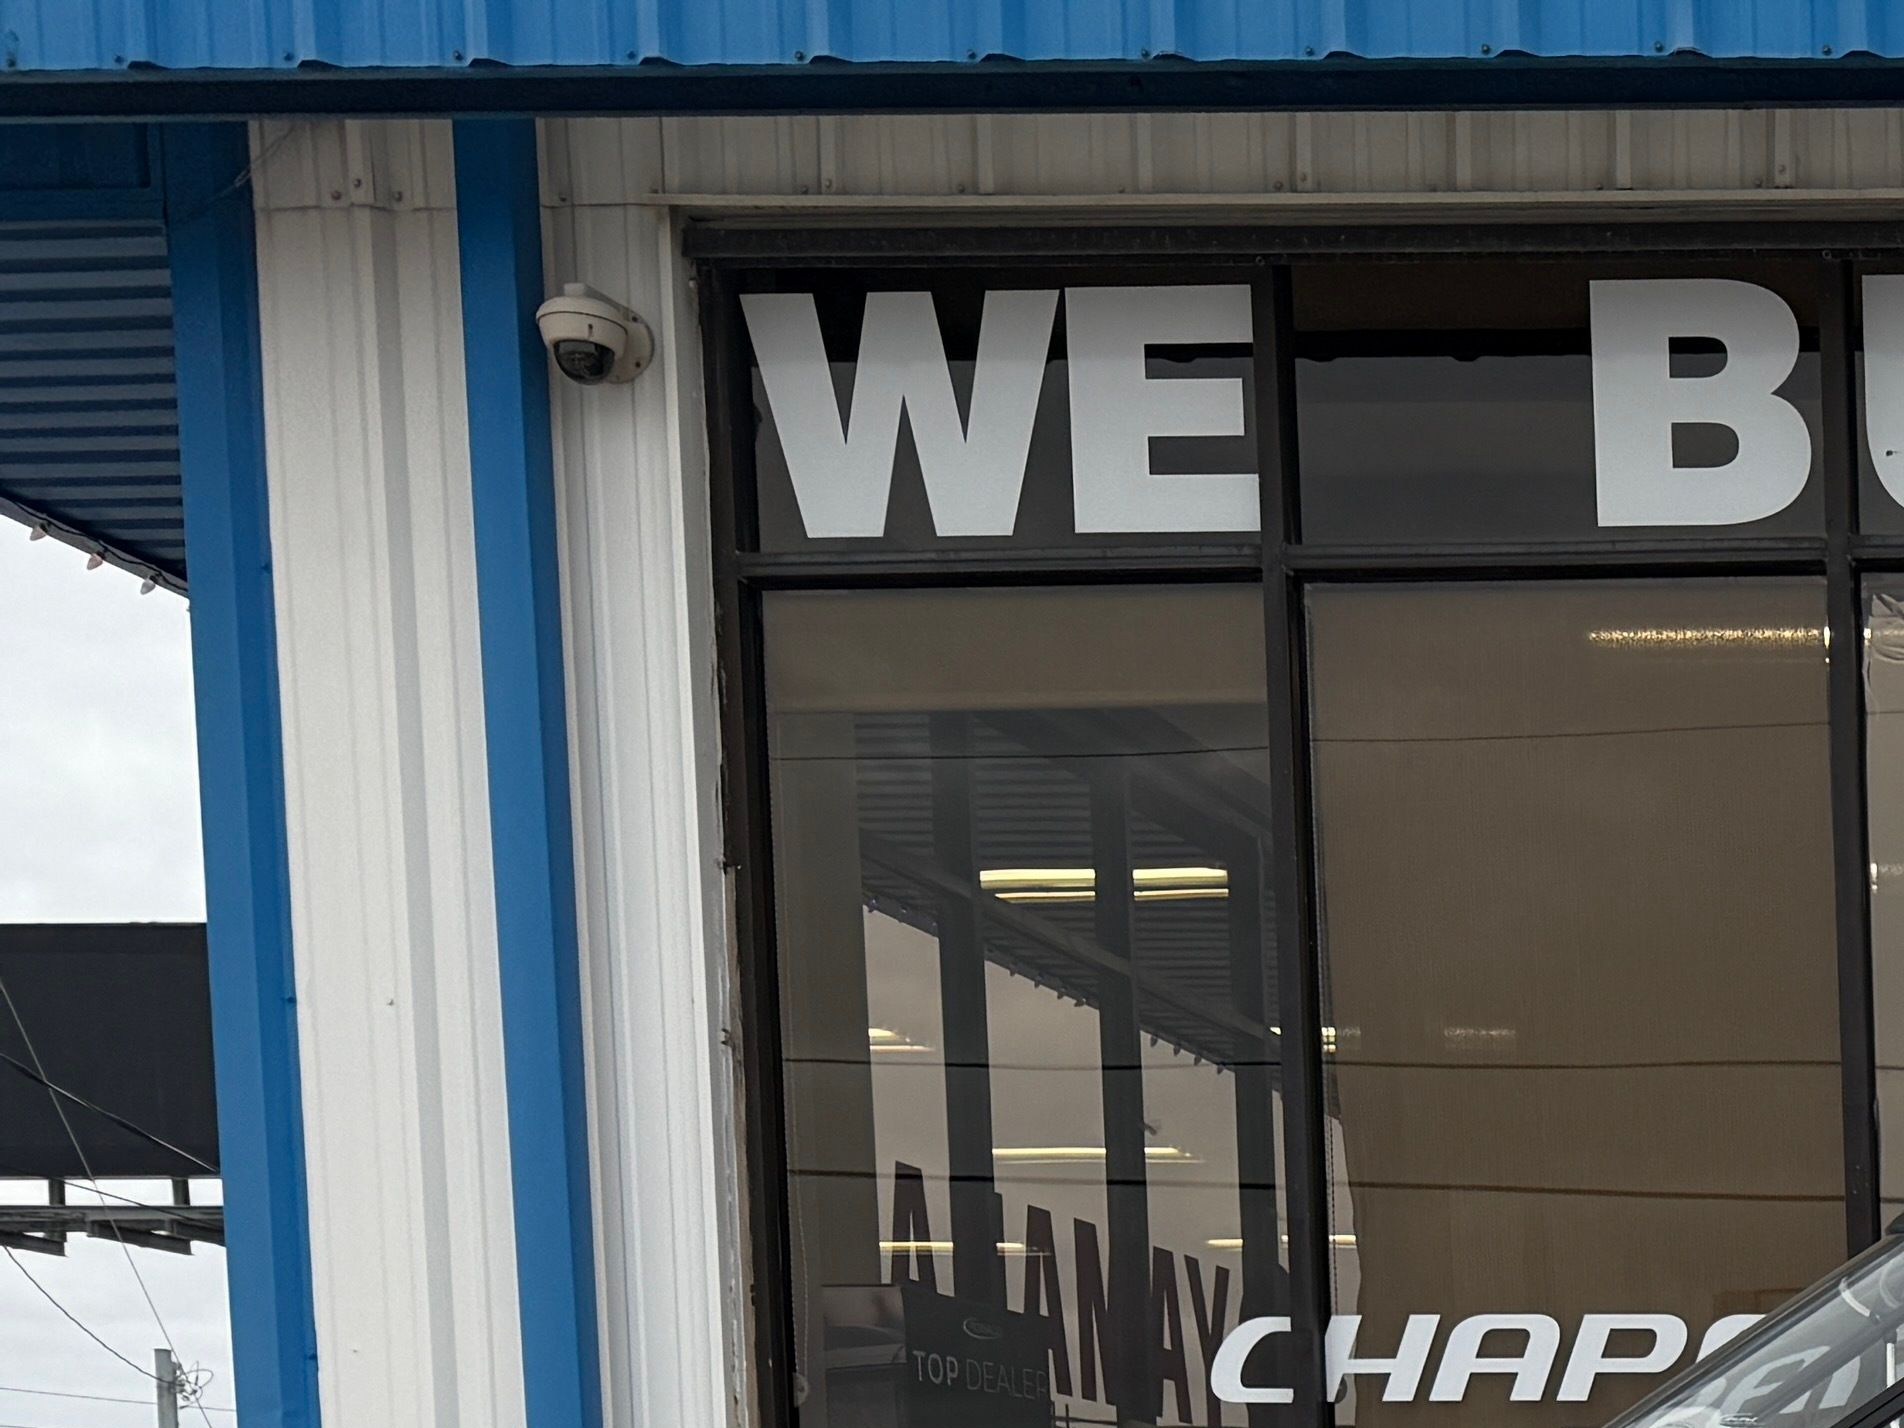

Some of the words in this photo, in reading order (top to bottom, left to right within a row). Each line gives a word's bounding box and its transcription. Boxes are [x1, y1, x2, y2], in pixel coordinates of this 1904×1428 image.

[740, 284, 1261, 538] WE
[912, 1349, 959, 1387] TOP
[966, 1356, 1048, 1400] DEALER
